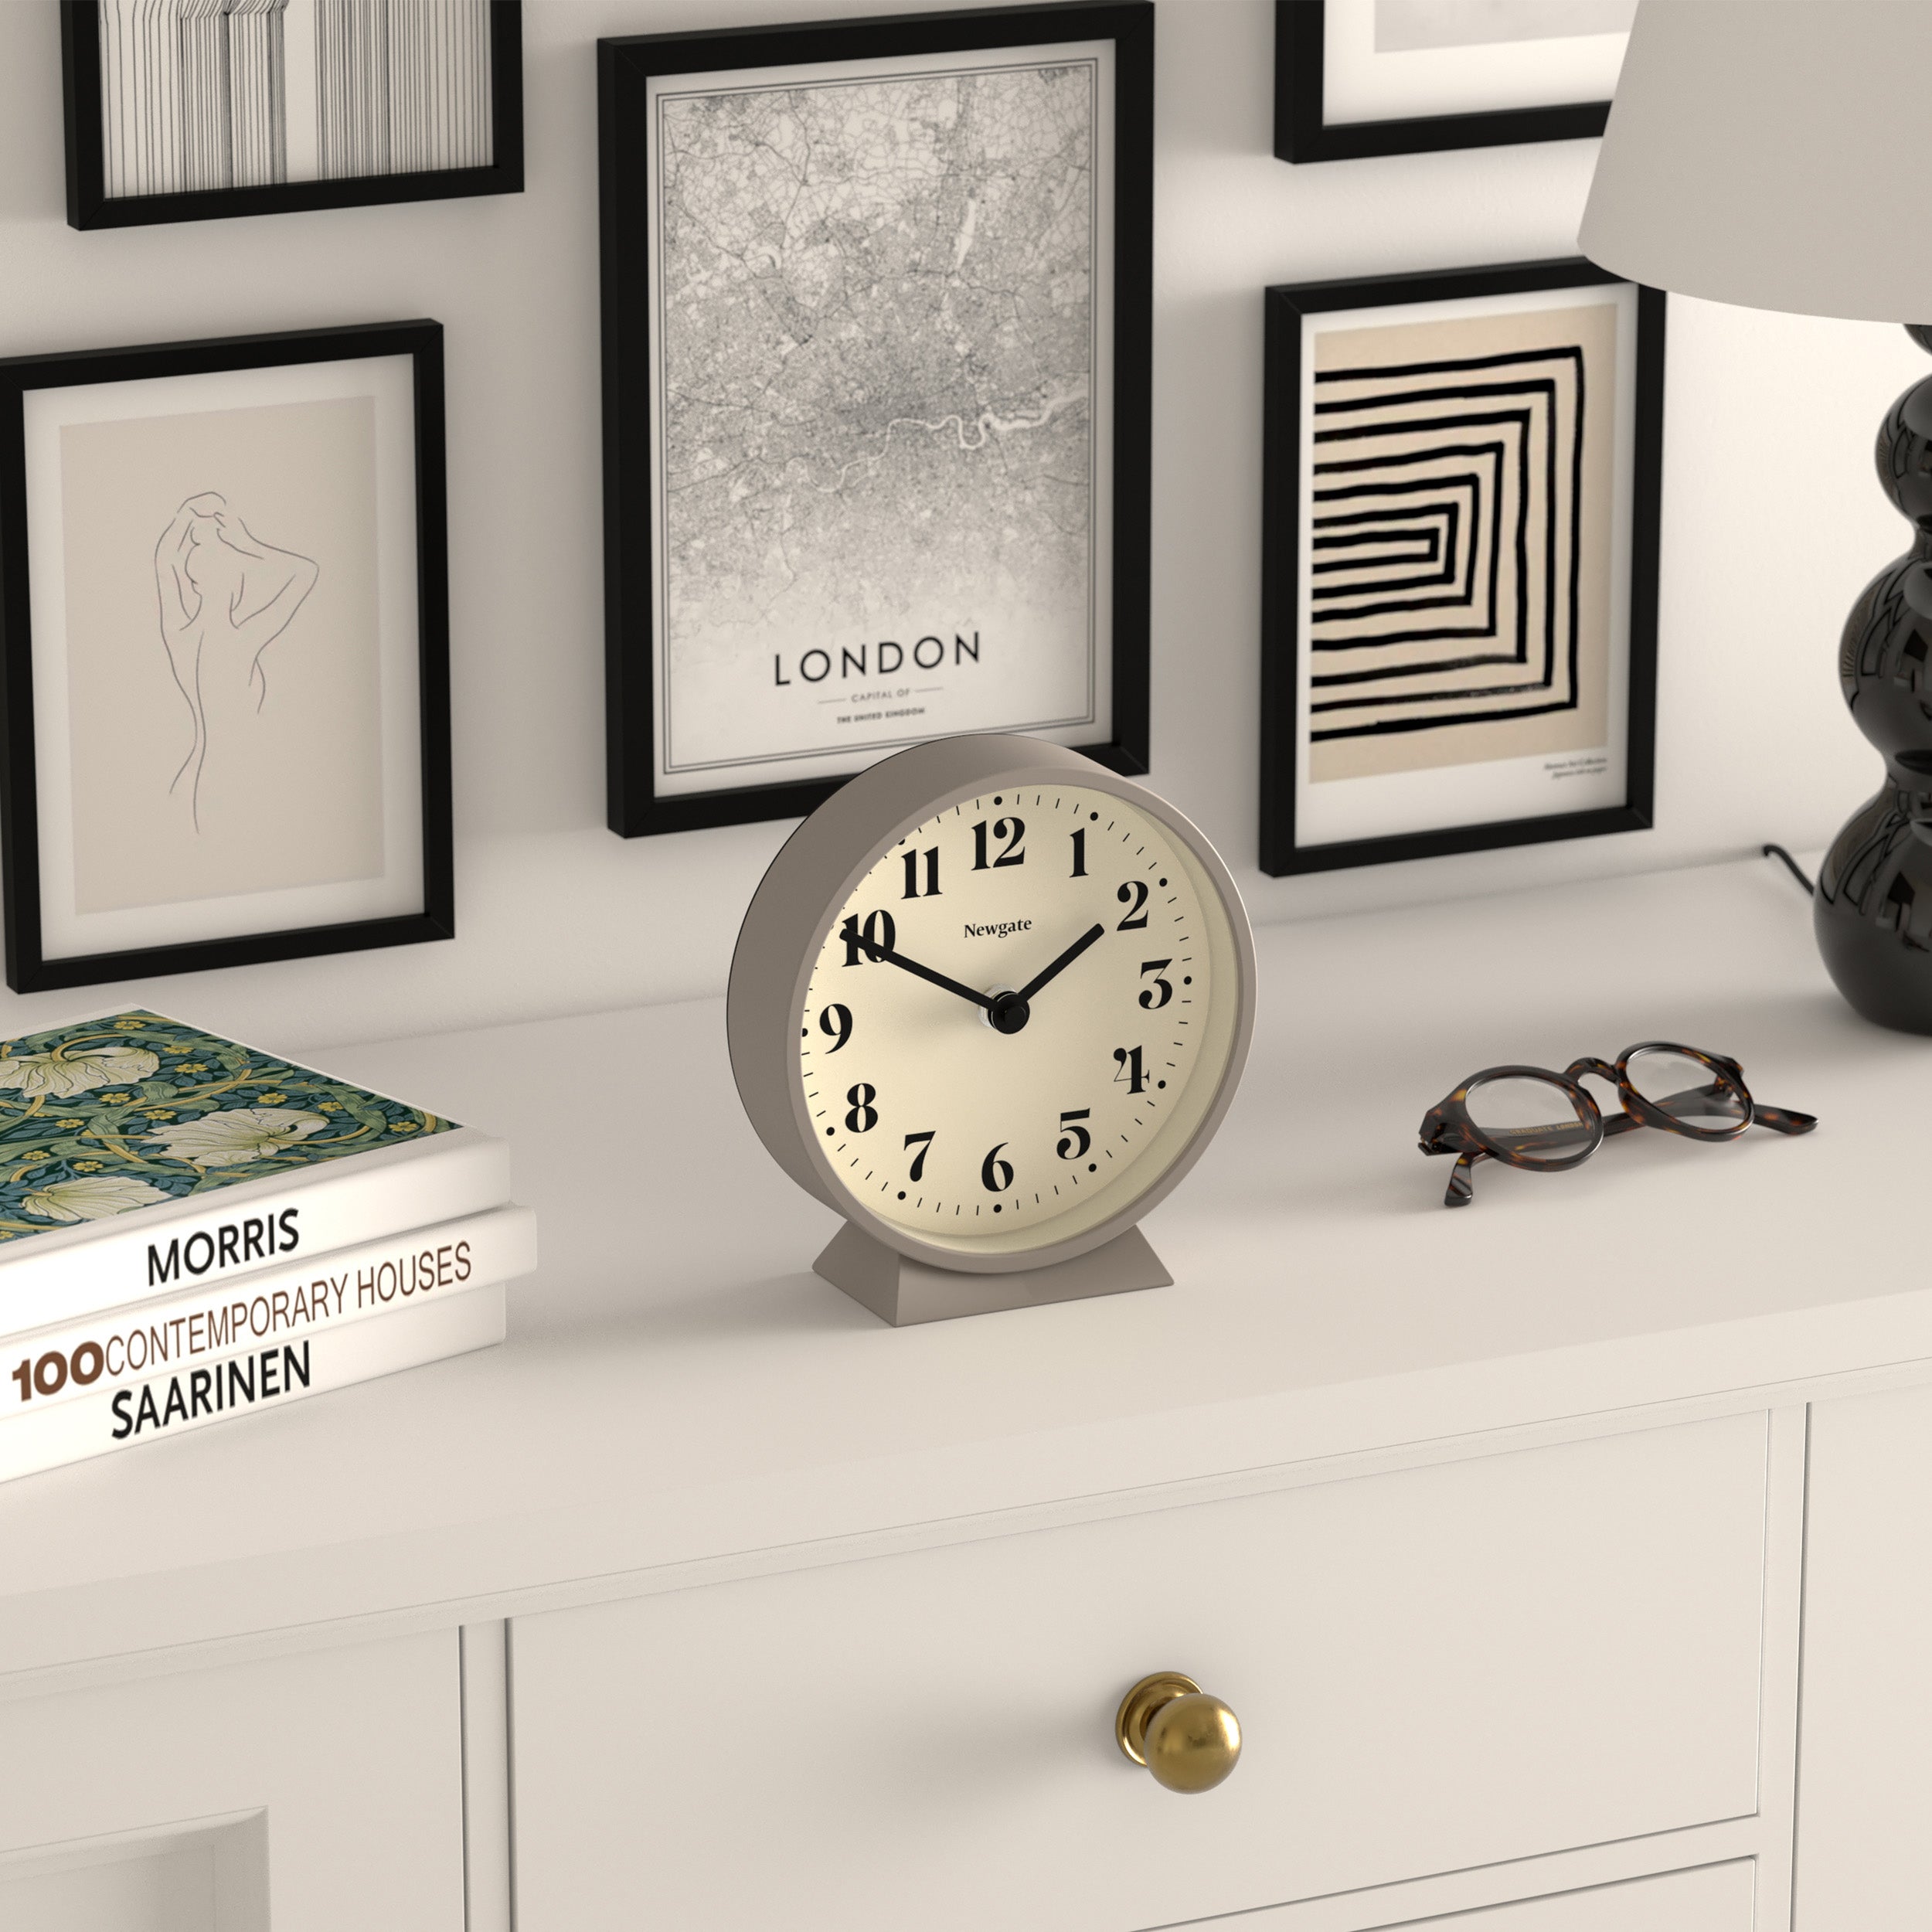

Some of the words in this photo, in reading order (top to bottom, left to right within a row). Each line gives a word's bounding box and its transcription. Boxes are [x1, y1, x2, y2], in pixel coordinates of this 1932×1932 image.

[774, 631, 979, 686] LONDON
[837, 715, 852, 724] THE
[854, 712, 883, 723] UNITED
[886, 707, 926, 718] KINGDOM
[851, 690, 893, 702] CAPITAL
[896, 688, 910, 697] OF
[971, 817, 1026, 871] 12
[1069, 827, 1089, 878] 1
[900, 845, 943, 900] 11
[964, 919, 1032, 939] Newgate
[1116, 880, 1149, 932] 2
[841, 910, 896, 968] 10
[1138, 958, 1173, 1010] 3
[819, 1003, 853, 1054] 9
[1113, 1045, 1150, 1095] 4
[845, 1083, 879, 1133] 8
[1056, 1107, 1091, 1160] 5
[903, 1131, 936, 1182] 7
[981, 1142, 1014, 1192] 6
[147, 1208, 300, 1287] MORRIS
[358, 1241, 471, 1308] HOUSES
[111, 1340, 311, 1440] SAARINEN
